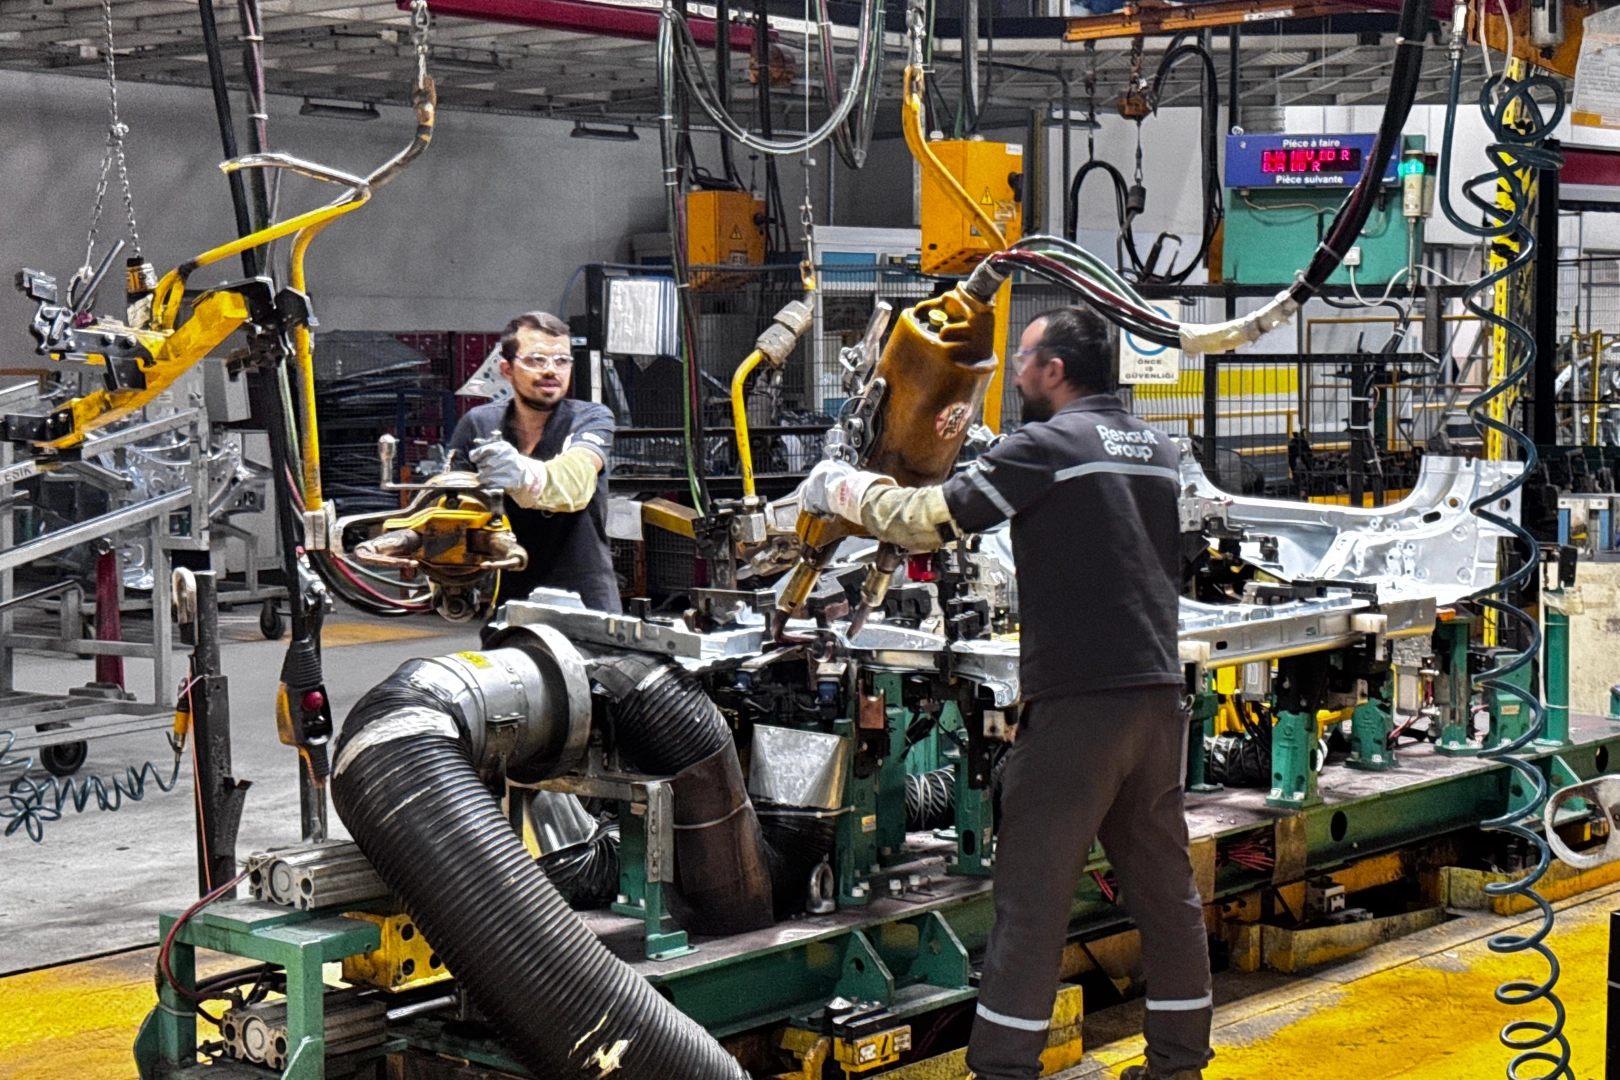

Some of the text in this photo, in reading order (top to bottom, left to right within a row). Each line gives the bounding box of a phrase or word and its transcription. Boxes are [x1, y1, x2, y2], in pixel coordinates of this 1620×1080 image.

[1310, 138, 1317, 148] à
[1319, 138, 1341, 148] faire
[1340, 148, 1350, 161] R
[1311, 160, 1321, 172] R
[1276, 174, 1344, 184] Pièce suivante
[1095, 424, 1159, 445] Renault
[1103, 439, 1153, 463] Group
